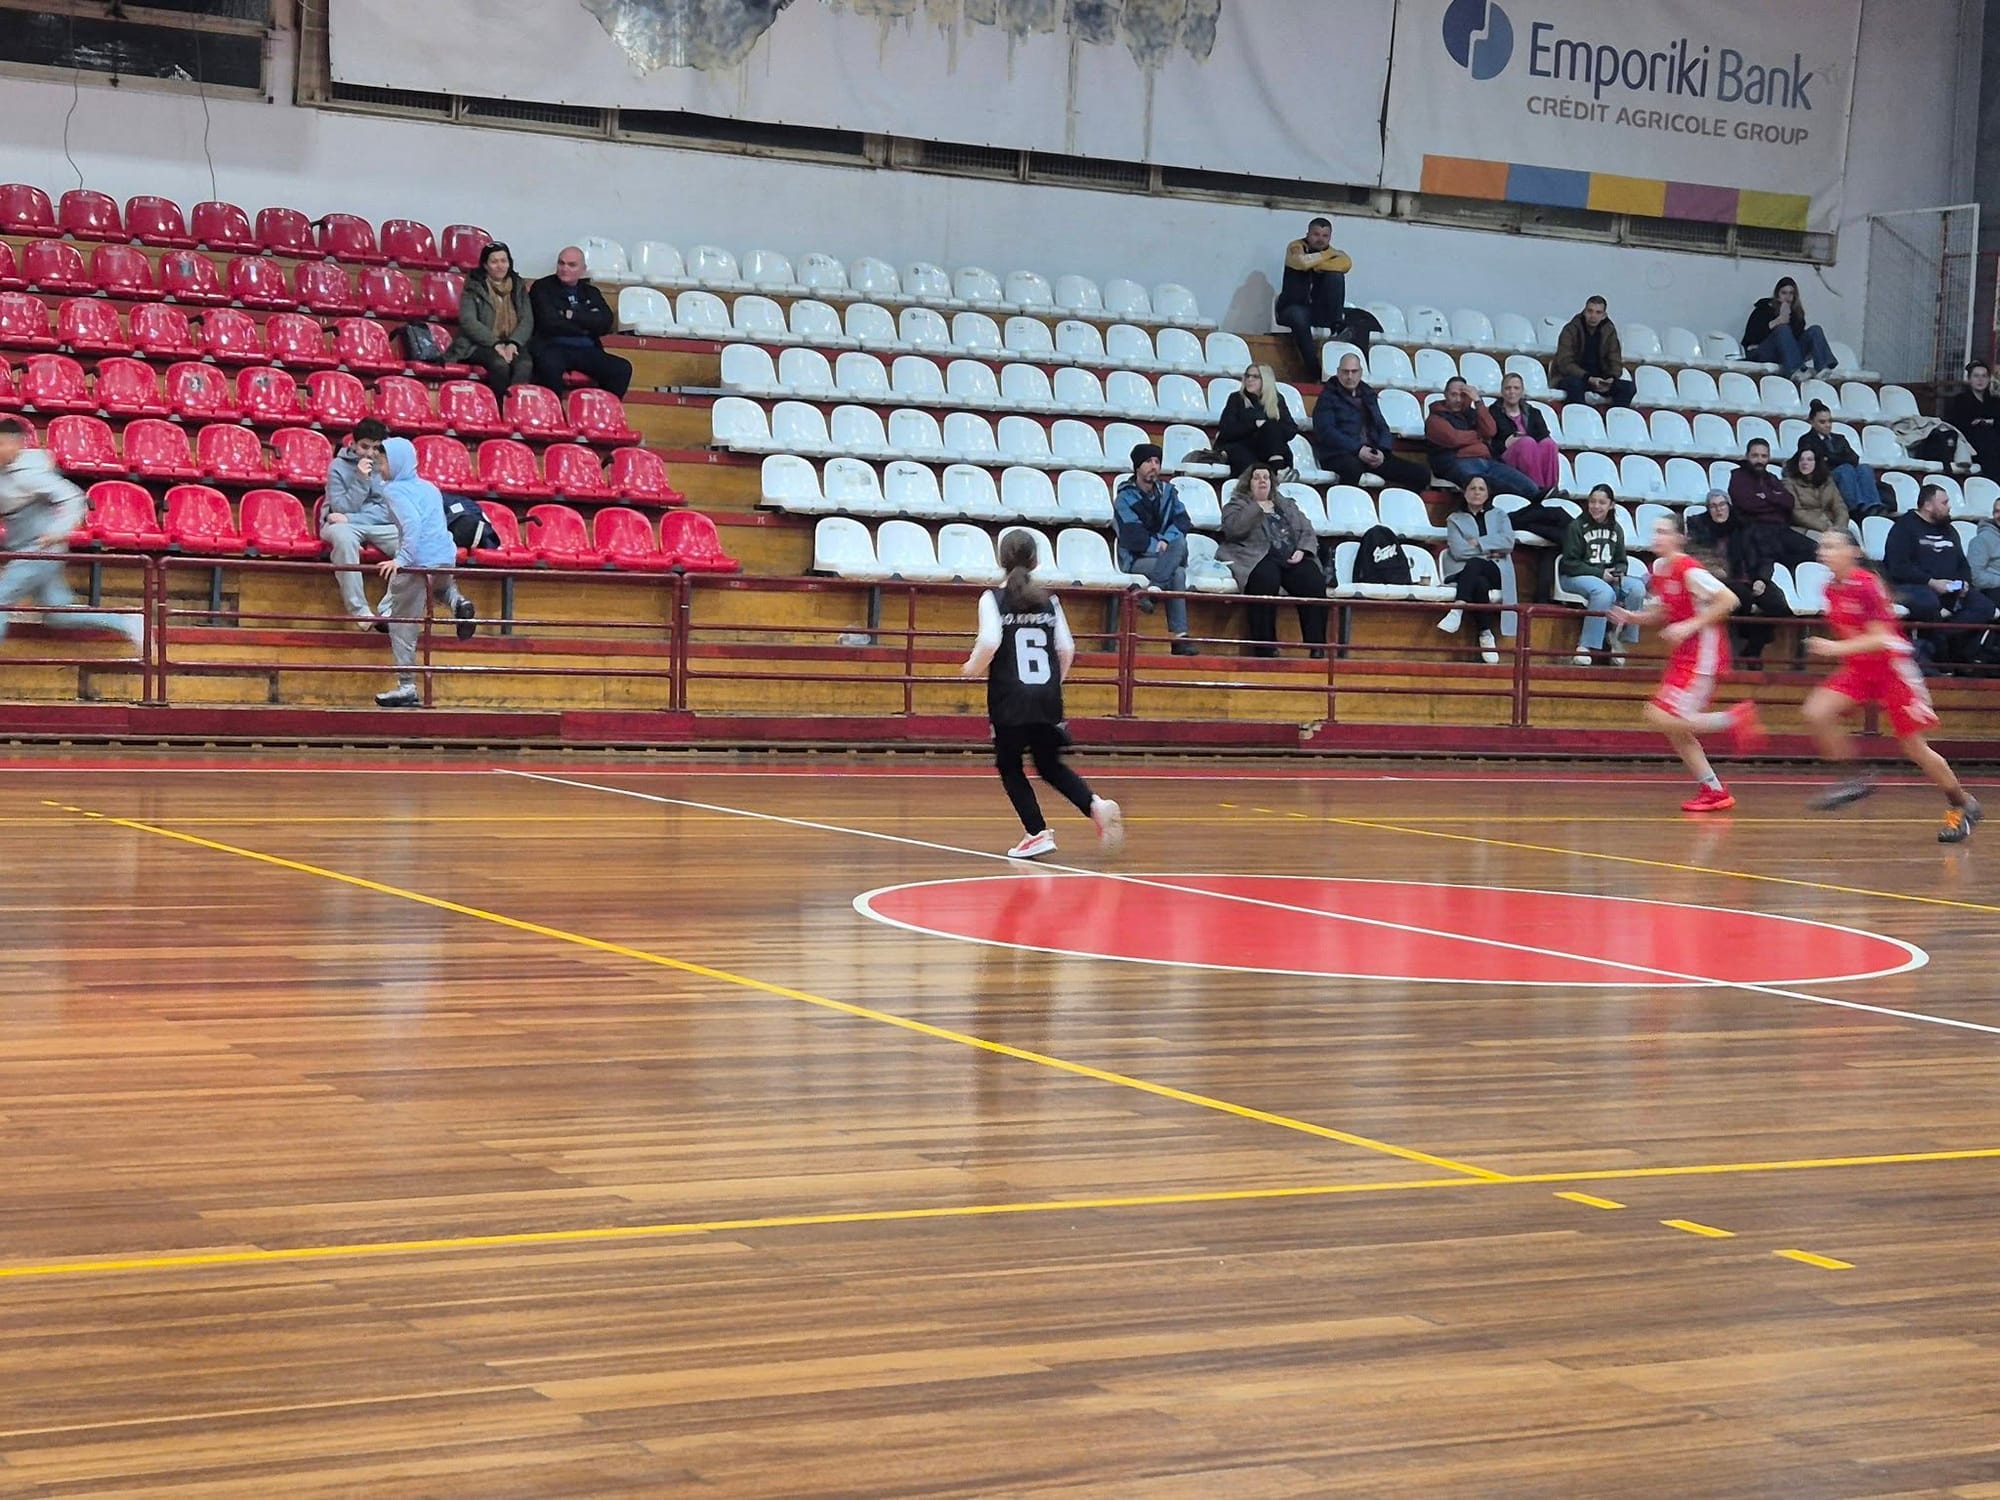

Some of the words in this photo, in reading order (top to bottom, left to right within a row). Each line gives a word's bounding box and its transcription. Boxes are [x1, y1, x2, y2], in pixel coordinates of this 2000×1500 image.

[1529, 22, 1709, 98] Emporiki
[1716, 49, 1813, 110] Bank
[1526, 95, 1610, 123] CRÉDIT
[1616, 107, 1727, 138] AGRICOLE
[1733, 121, 1809, 147] GROUP
[1589, 543, 1613, 564] 34
[1014, 627, 1052, 685] 6
